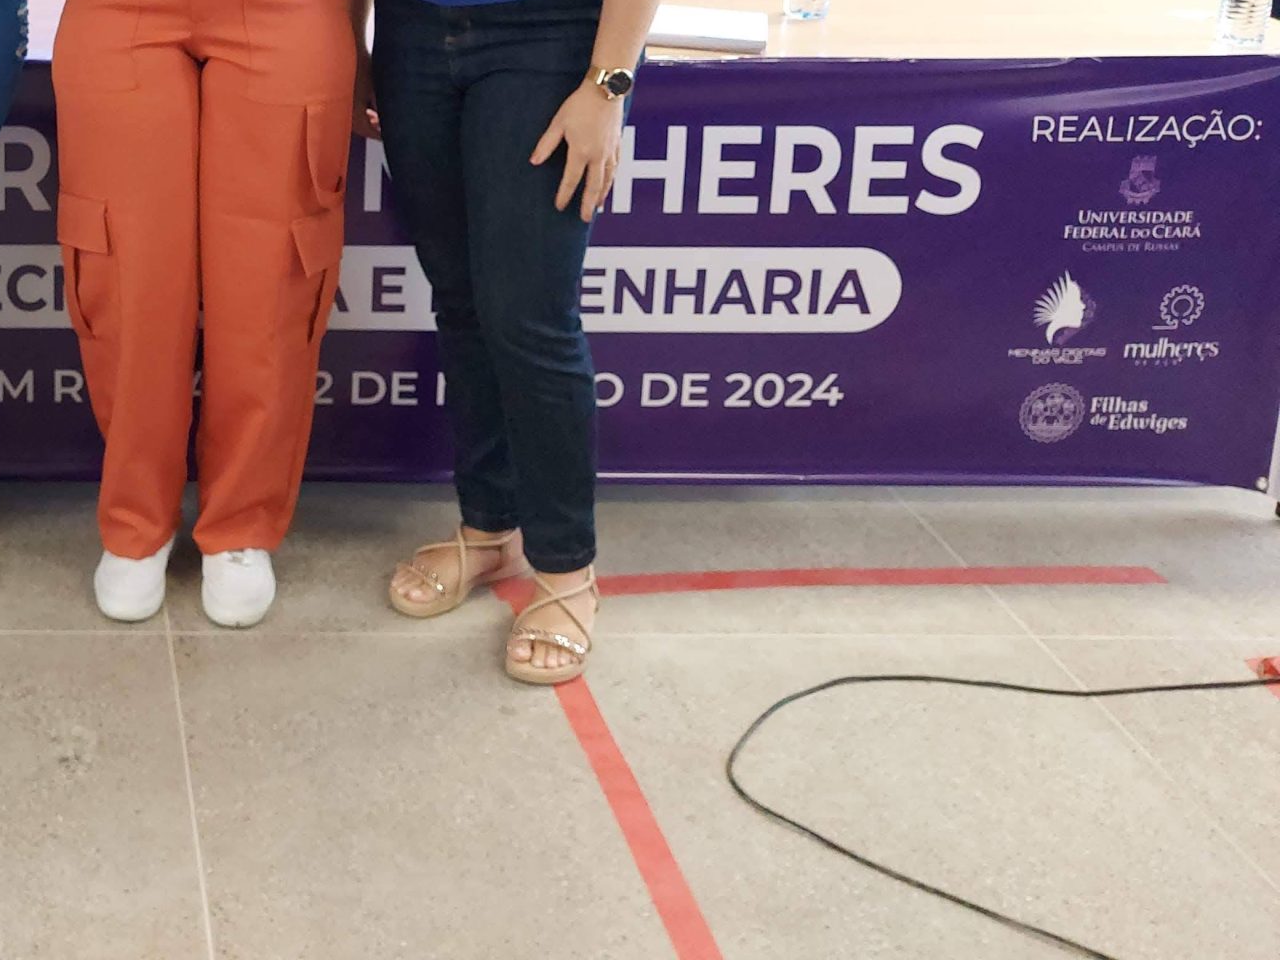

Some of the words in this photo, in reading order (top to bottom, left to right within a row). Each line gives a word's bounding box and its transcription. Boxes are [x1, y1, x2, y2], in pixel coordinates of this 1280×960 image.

[1032, 109, 1263, 148] REALIZAÇÃO:
[1078, 209, 1194, 224] UNIVERSIDADE
[1064, 225, 1128, 239] FEDERAL
[1130, 228, 1151, 239] DO
[1152, 222, 1201, 239] CEARÁ
[372, 266, 406, 312] E
[579, 268, 871, 315] ENHARIA
[1124, 337, 1219, 361] mulheres
[351, 371, 418, 405] DE
[641, 373, 711, 407] DE
[723, 372, 845, 408] 2024
[1090, 396, 1149, 413] Filhas
[1090, 413, 1108, 426] de
[1108, 413, 1189, 434] Edwiges
